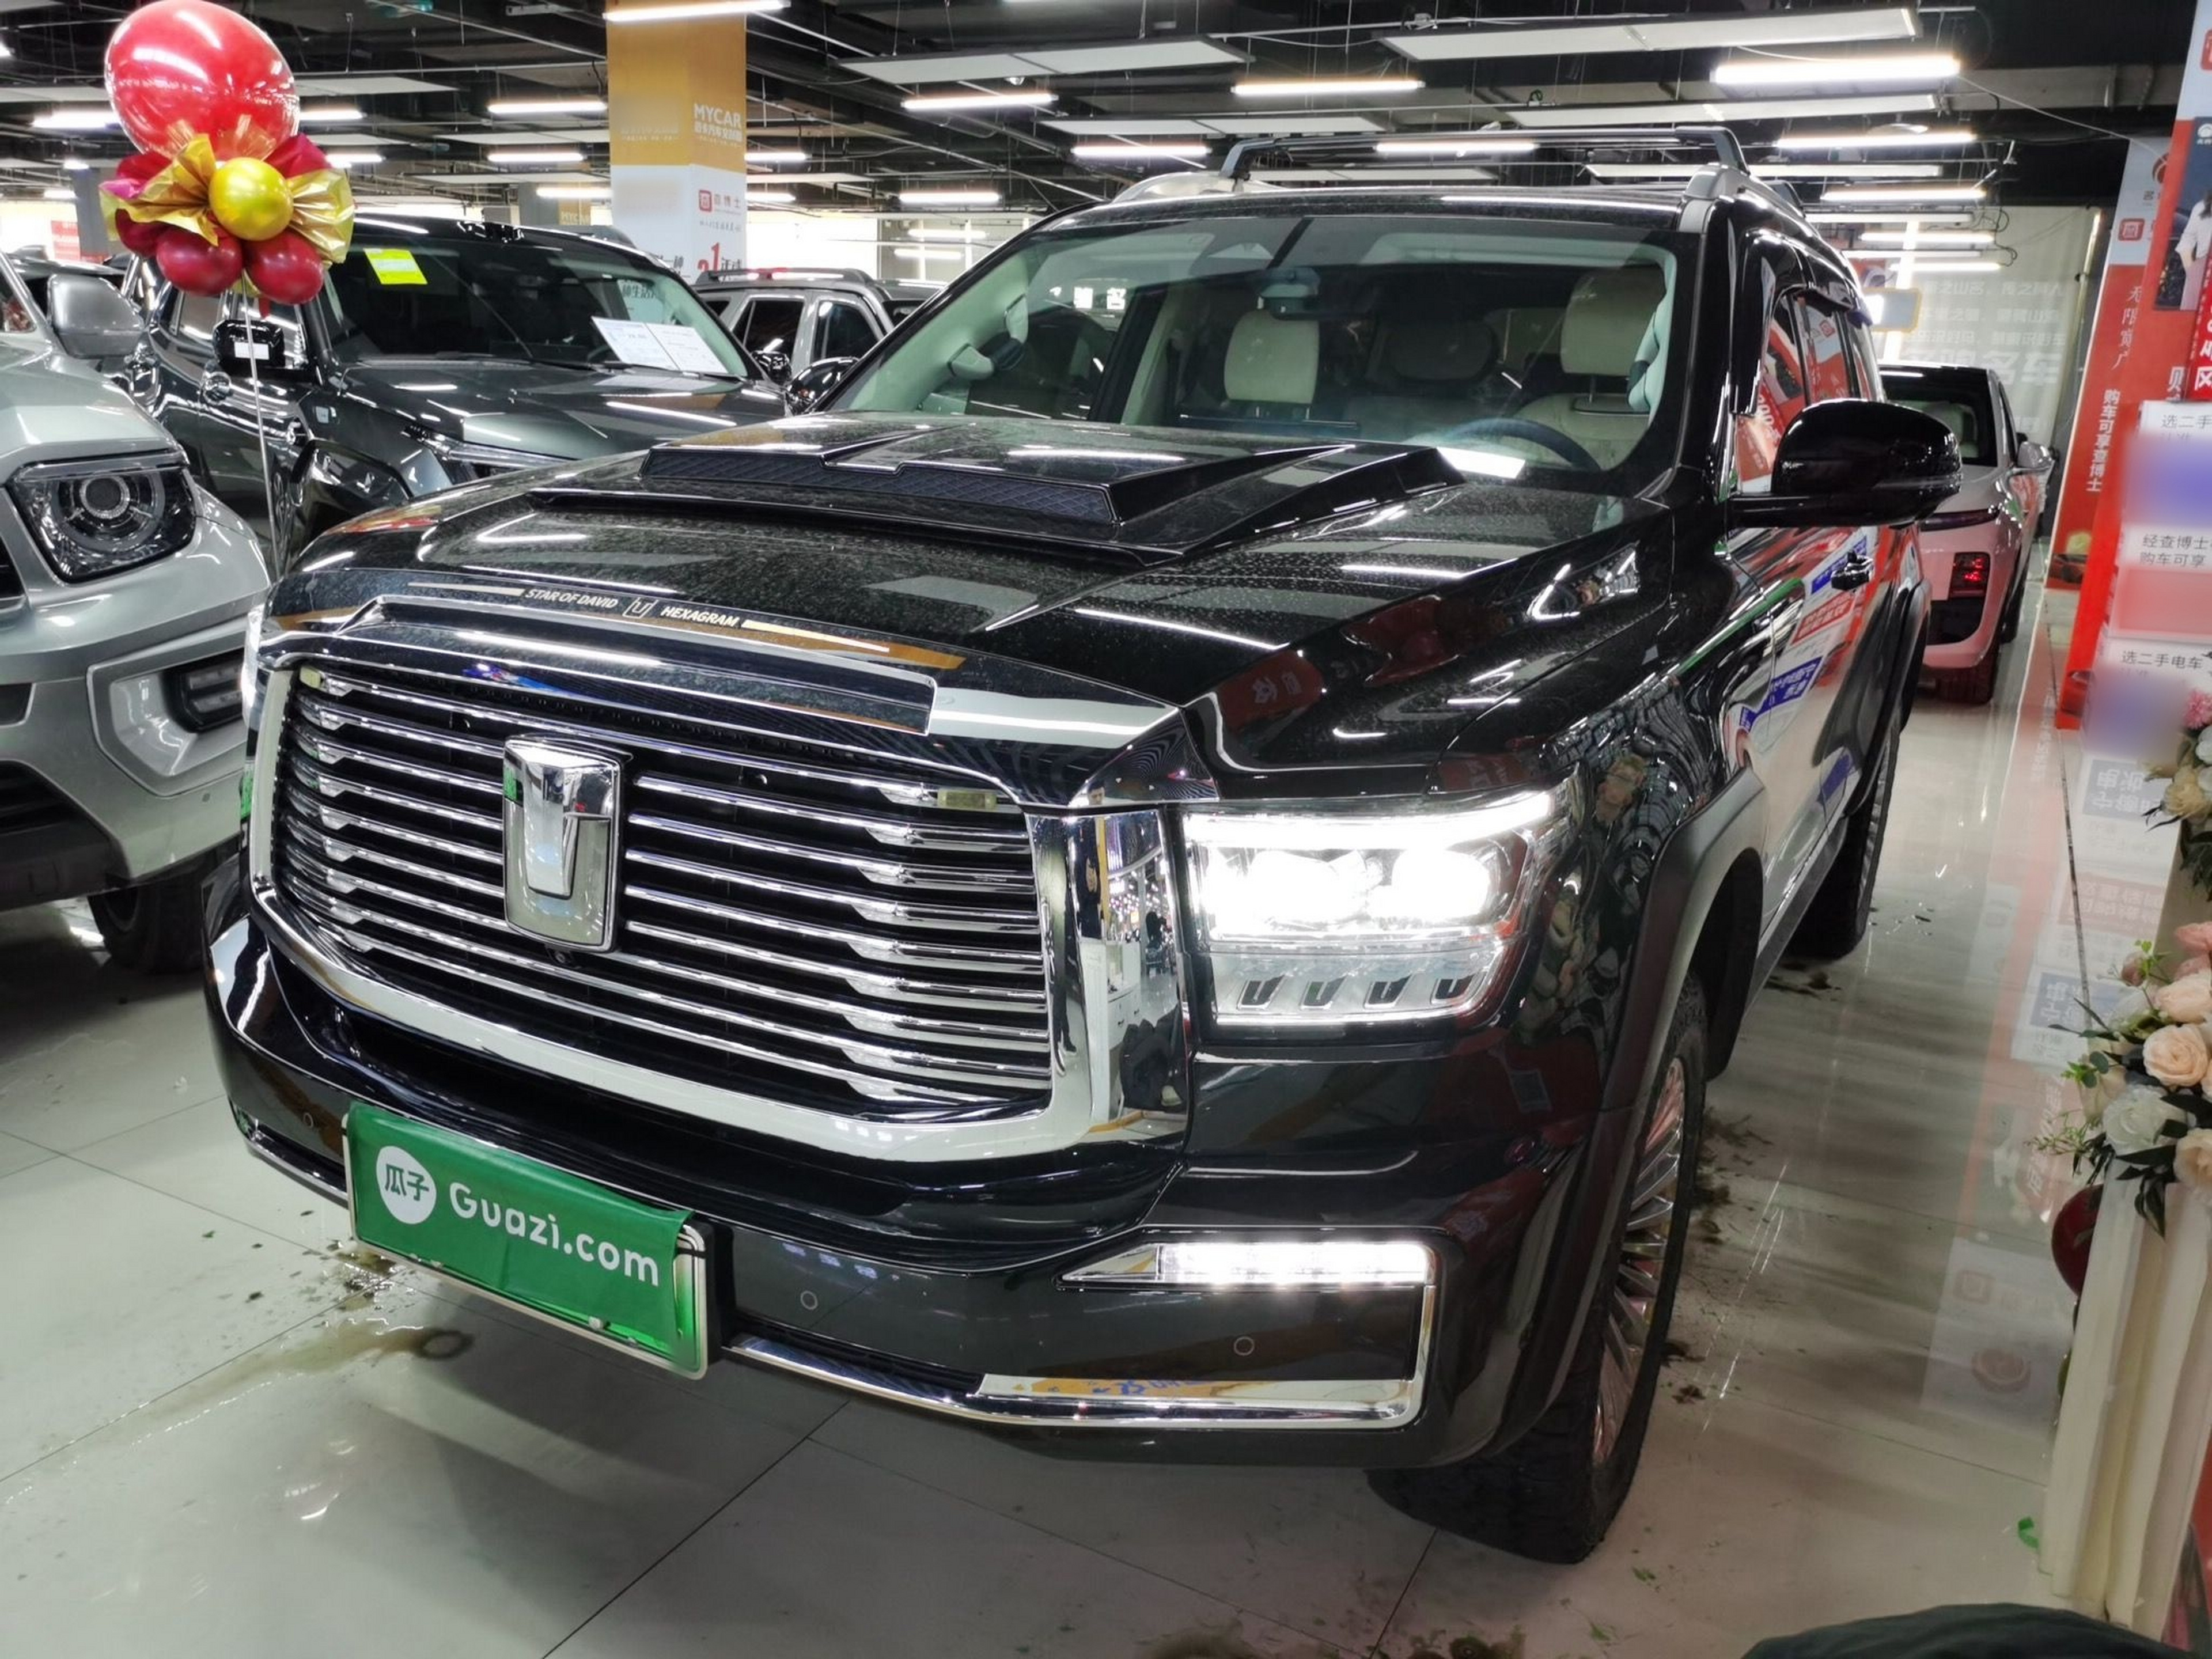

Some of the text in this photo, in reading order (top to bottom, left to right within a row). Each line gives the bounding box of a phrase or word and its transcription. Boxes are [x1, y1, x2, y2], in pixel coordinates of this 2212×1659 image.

[694, 103, 743, 129] MYCAR
[2086, 388, 2121, 492] 购车可享查博士
[2142, 533, 2212, 550] 经查博士
[2139, 552, 2207, 569] 购车可享
[525, 589, 740, 627] STAR OF DAVID HEXAGRAM
[2122, 650, 2203, 670] 选二手电车
[384, 1163, 430, 1202] 瓜子
[449, 1182, 660, 1286] Guazi.com
